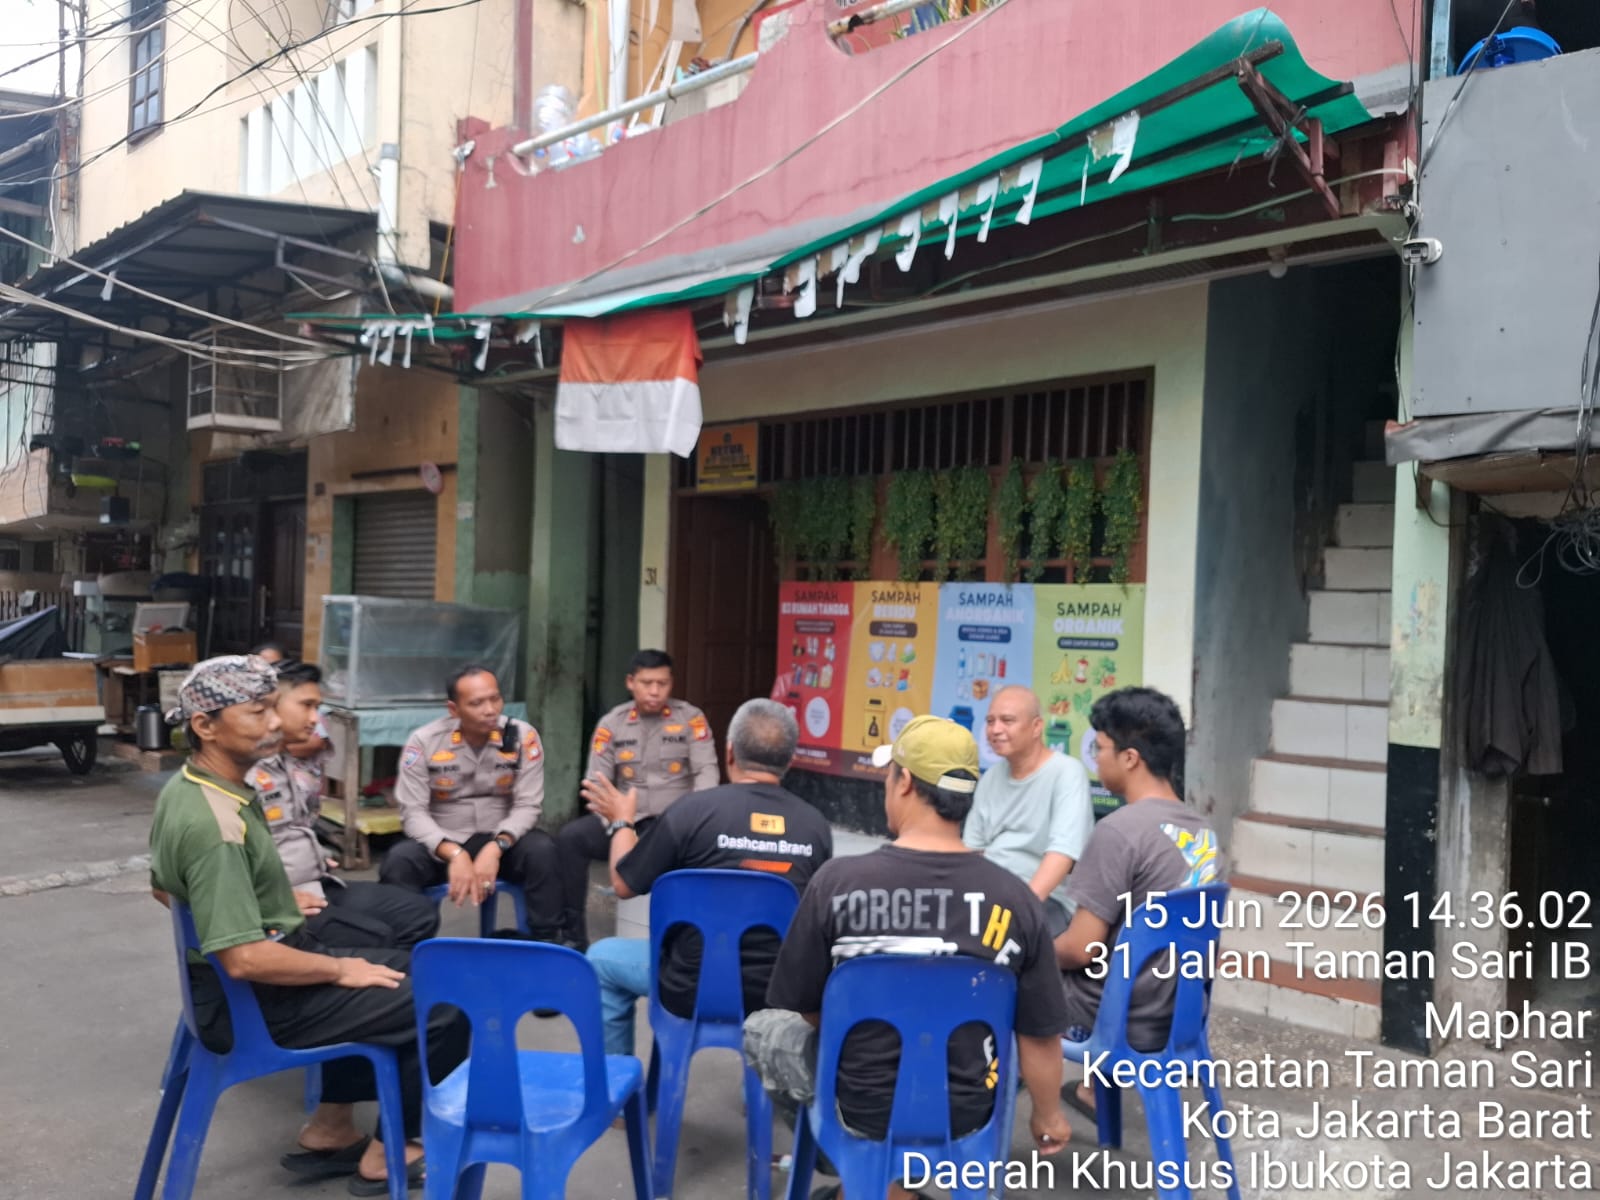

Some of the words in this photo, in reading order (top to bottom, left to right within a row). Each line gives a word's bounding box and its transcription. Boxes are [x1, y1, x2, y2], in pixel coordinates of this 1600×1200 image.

[794, 589, 839, 601] SAMPAH
[871, 589, 921, 603] SAMPAH
[958, 591, 1014, 607] SAMPAH
[1056, 602, 1122, 616] SAMPAH
[1052, 618, 1124, 635] ORGANIK
[760, 820, 777, 829] #1
[717, 834, 777, 853] Dashcam
[778, 840, 813, 857] Brand
[831, 888, 953, 934] FORGET
